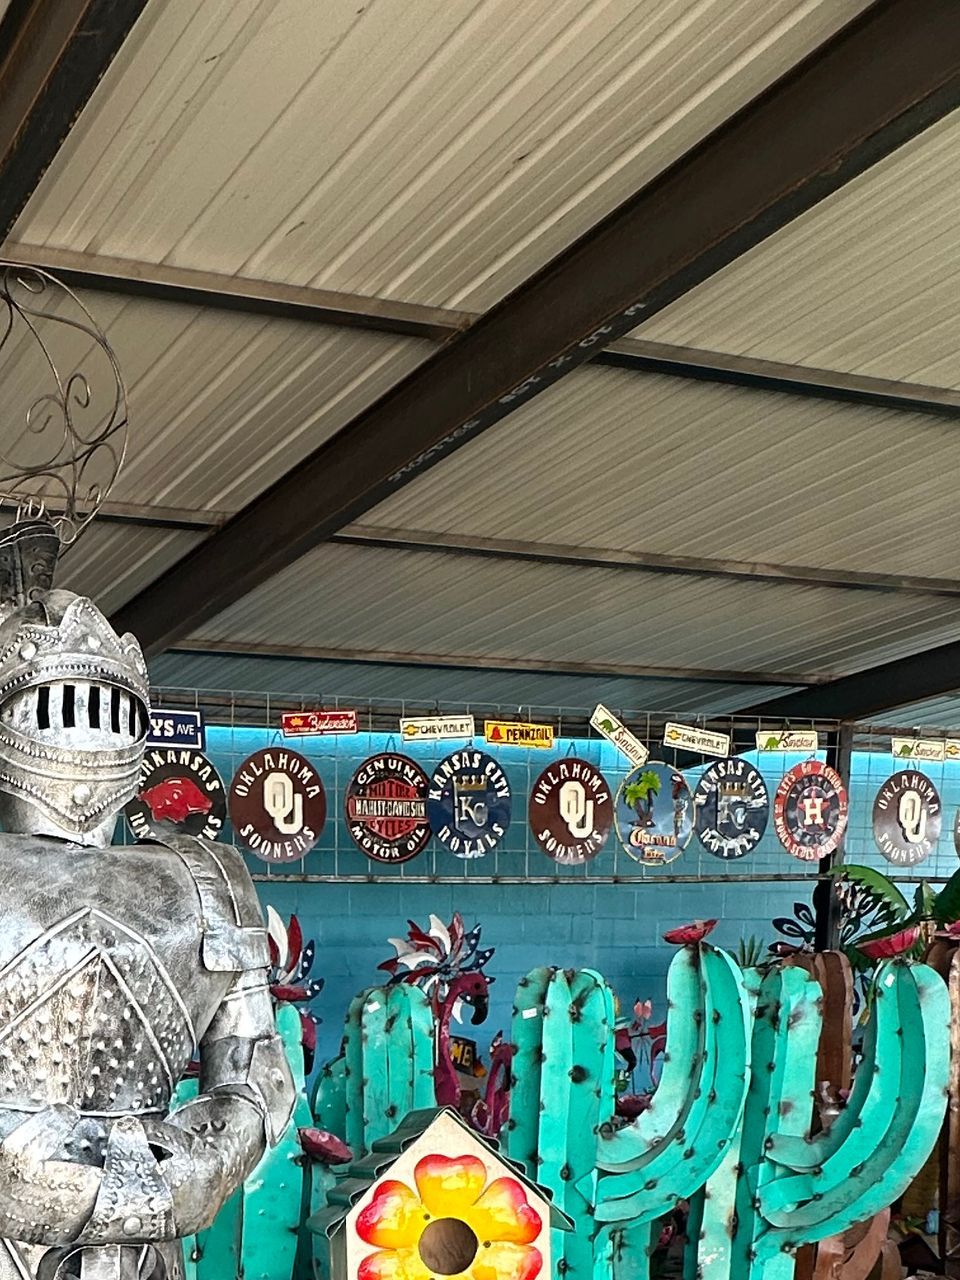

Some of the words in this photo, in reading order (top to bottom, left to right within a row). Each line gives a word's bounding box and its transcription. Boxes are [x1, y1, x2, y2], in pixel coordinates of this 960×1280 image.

[176, 724, 195, 736] AVE
[420, 723, 471, 735] CHEVROLET
[614, 728, 642, 763] Sinclair
[234, 753, 321, 799] OKLAHOMA
[357, 758, 423, 787] GENUINE
[428, 752, 482, 801] KANSAS
[485, 761, 510, 799] CITY
[534, 763, 609, 805] OKLAHOMA
[694, 760, 745, 806] KANSAS
[747, 770, 768, 805] CITY
[878, 774, 939, 814] OKLAHOMA
[239, 823, 316, 859] SOONERS
[351, 825, 401, 858] MOTOR
[406, 828, 426, 851] OIL
[438, 822, 504, 856] ROYALS
[538, 829, 602, 860] SOONERS
[878, 832, 932, 862] SOONERS
